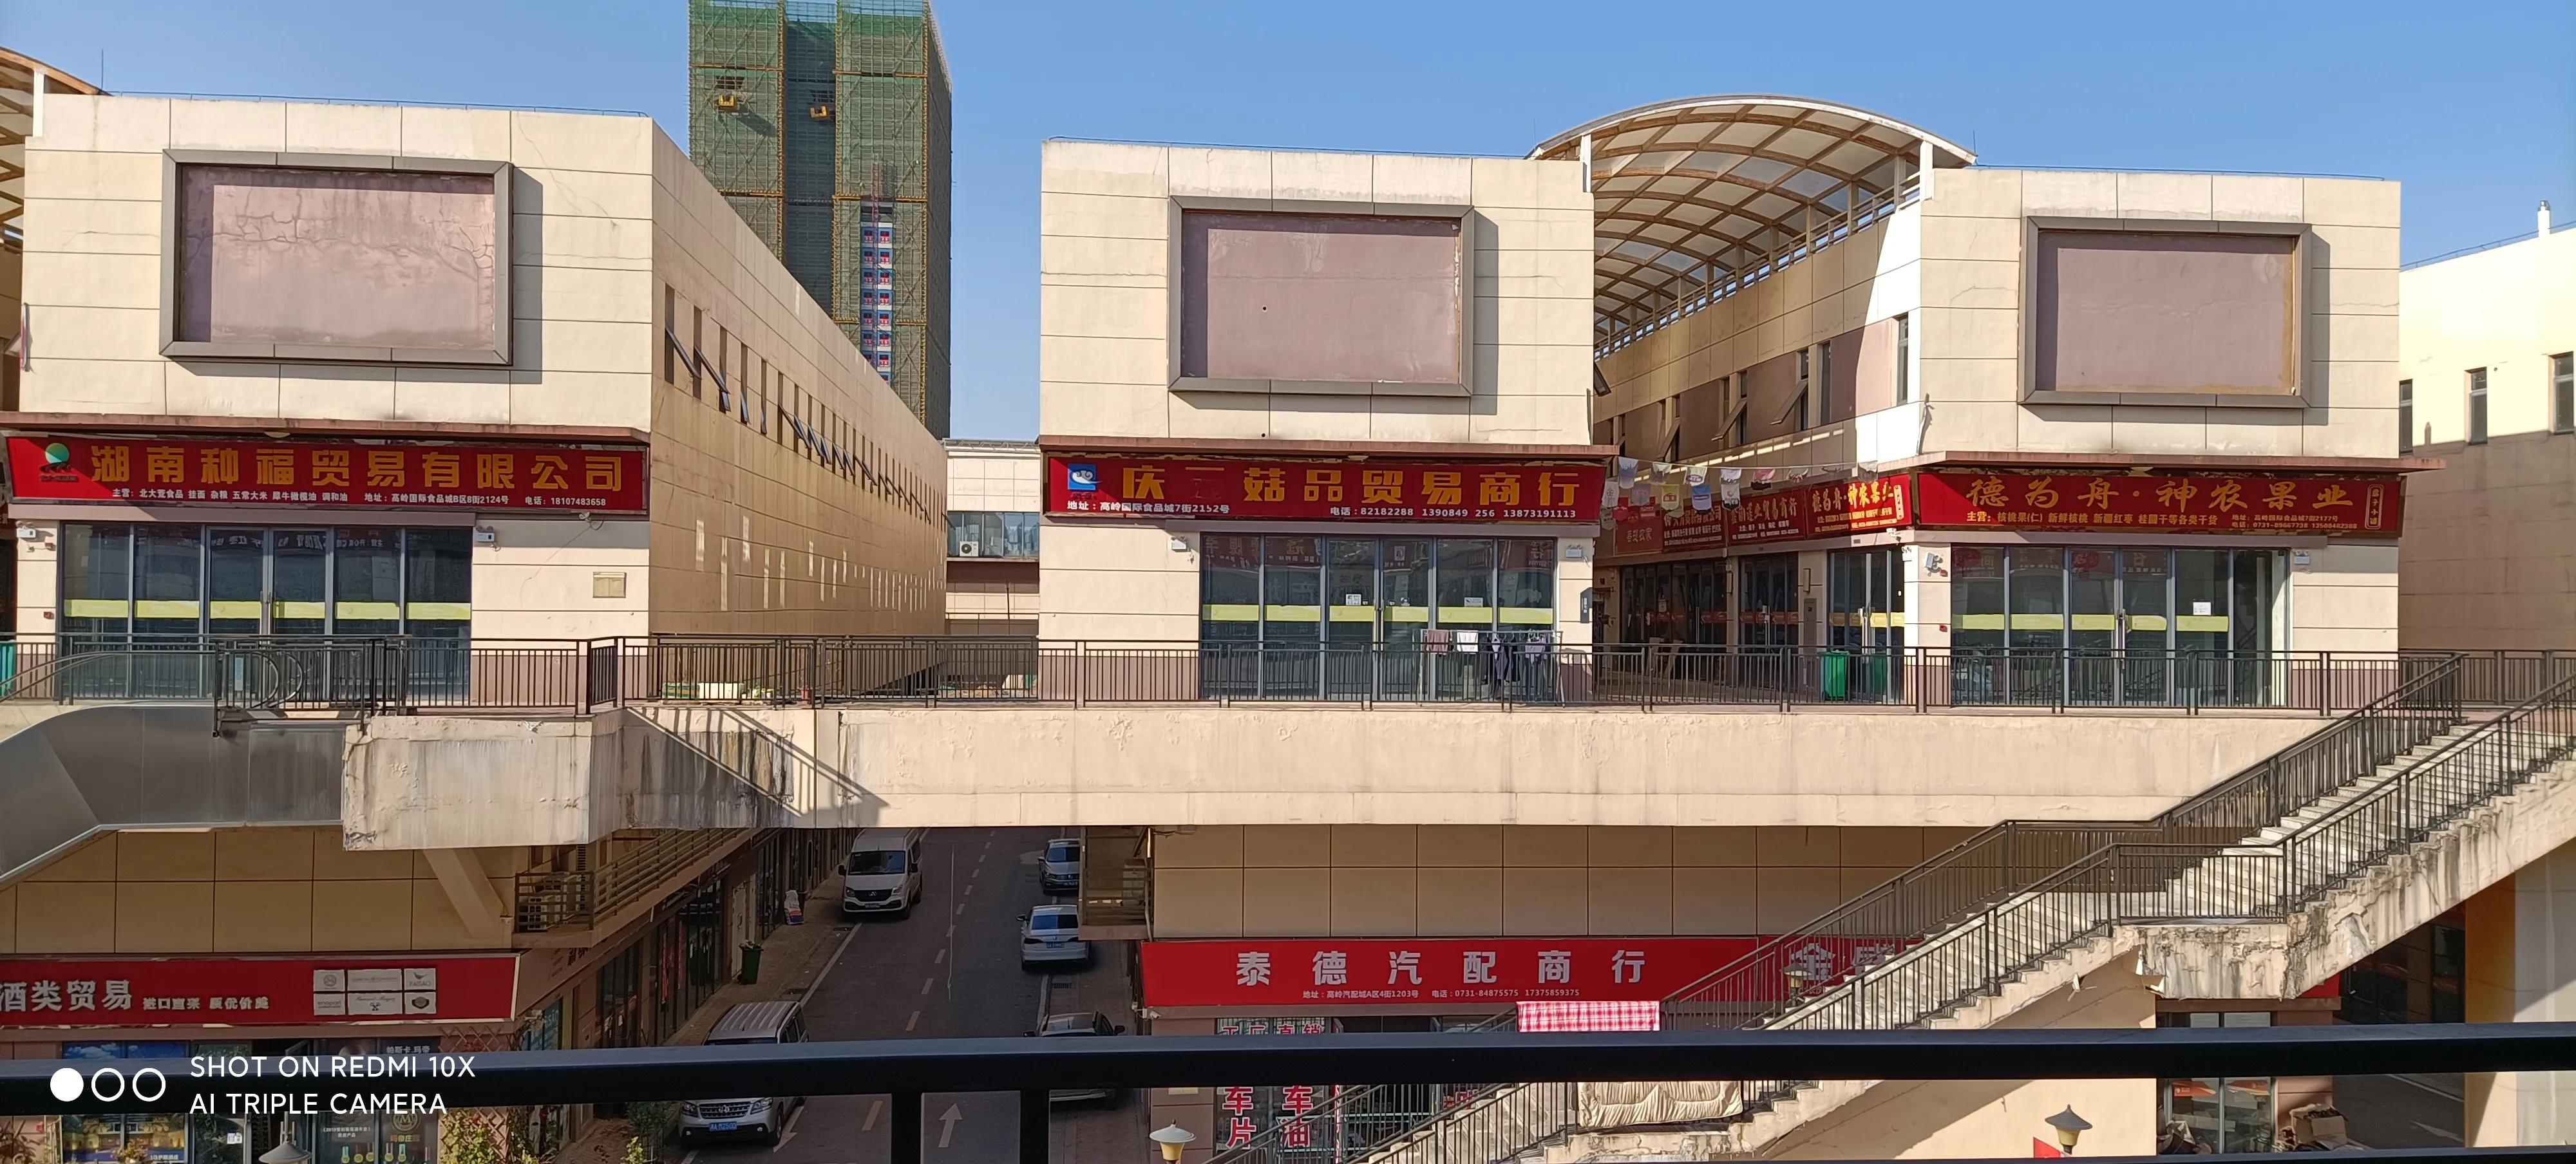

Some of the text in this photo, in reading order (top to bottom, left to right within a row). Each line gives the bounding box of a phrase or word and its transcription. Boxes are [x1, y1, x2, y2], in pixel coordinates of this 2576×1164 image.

[91, 446, 621, 491] 湖南种福贸易有限公司
[188, 490, 205, 499] 挂面
[211, 491, 228, 499] 杂粮
[232, 491, 268, 500] 五常大米
[322, 493, 348, 502] 调和油
[1422, 509, 1468, 518] 1390849
[1475, 509, 1495, 518] 256
[1504, 510, 1576, 518] 13873191113
[2093, 513, 2133, 524] 新疆红枣
[1236, 950, 1645, 986] 泰德汽配商行
